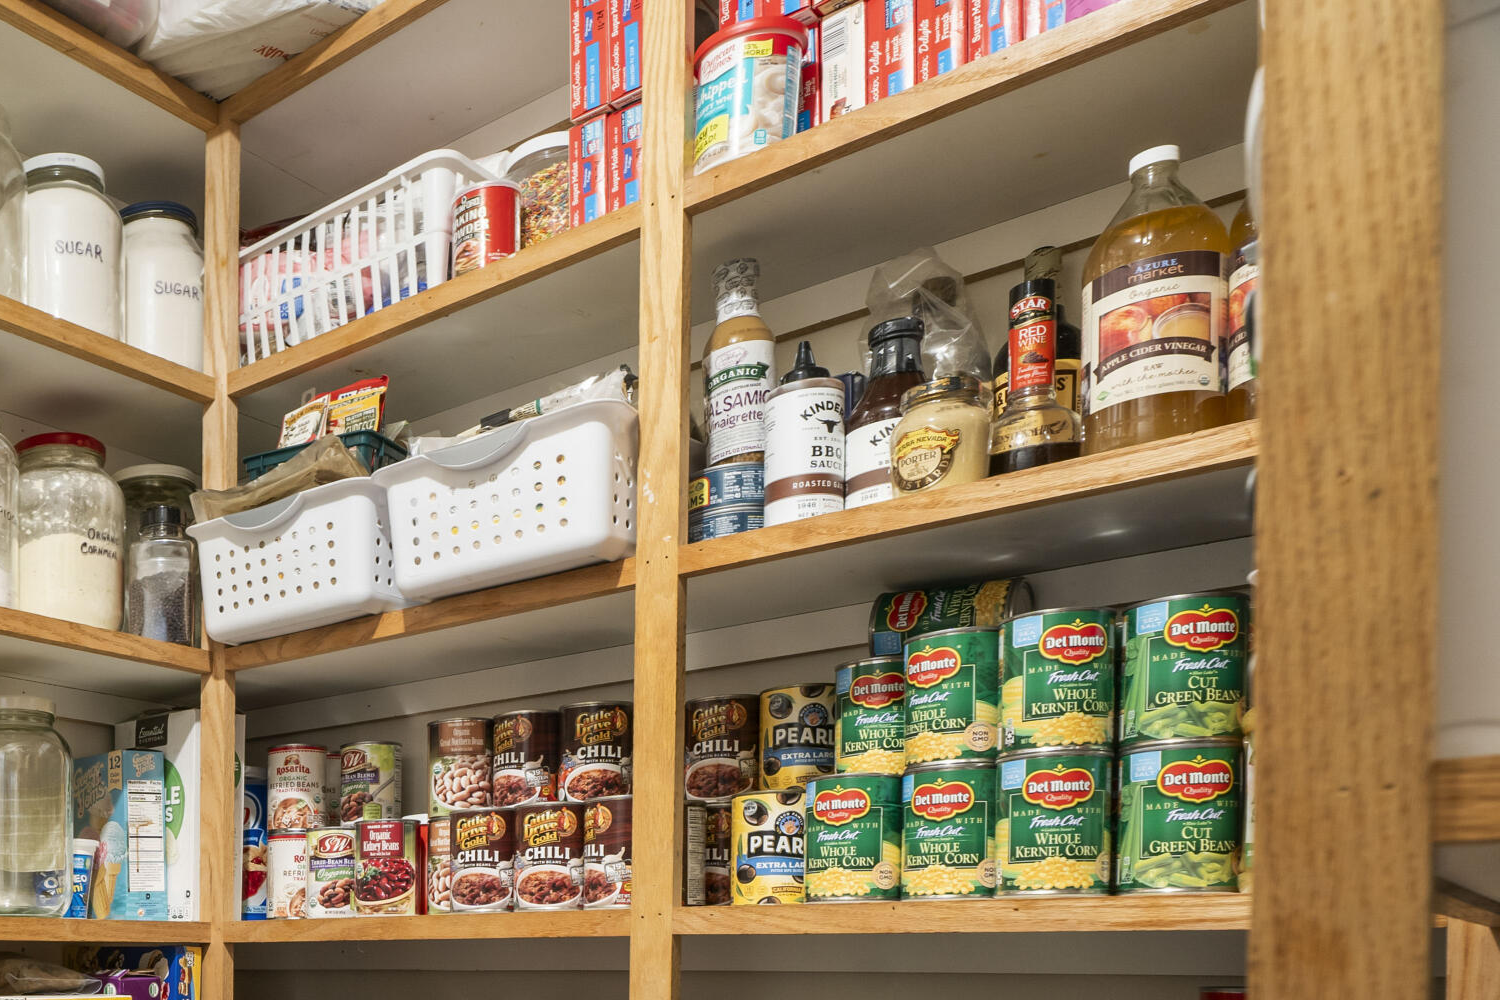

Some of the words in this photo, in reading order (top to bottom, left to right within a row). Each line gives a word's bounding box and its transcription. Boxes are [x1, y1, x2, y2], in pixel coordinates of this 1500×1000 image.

[54, 239, 103, 263] SUGAR
[1135, 258, 1179, 273] AZURE
[1128, 265, 1185, 285] market
[154, 280, 200, 300] SUGAR
[1011, 299, 1047, 314] STAR
[1018, 325, 1047, 338] RED
[1017, 335, 1046, 347] WINE
[1100, 356, 1129, 374] APPLE
[1130, 344, 1163, 360] CIDER
[1166, 342, 1207, 353] VINEGAR
[709, 367, 758, 389] ORGANIC
[900, 451, 937, 467] PORTER
[792, 480, 831, 489] ROASTED
[1171, 622, 1194, 635] Del
[1197, 620, 1236, 633] Monte
[1046, 636, 1066, 649] Del
[1069, 634, 1104, 648] Monte
[1188, 677, 1218, 689] CUT
[1054, 688, 1097, 700] WHOLE
[1156, 691, 1203, 704] GREEN
[1207, 689, 1241, 701] BEANS
[1031, 703, 1080, 715] KERNEL
[1083, 700, 1109, 713] CORN
[577, 745, 621, 760] CHILI
[693, 739, 739, 755] CHILI
[109, 756, 120, 770] 12
[781, 752, 811, 760] EXTRA
[277, 764, 310, 775] Rosarita
[370, 830, 391, 841] Organic
[363, 841, 381, 851] Kidney
[382, 841, 399, 850] Beans
[457, 850, 499, 863] CHILI
